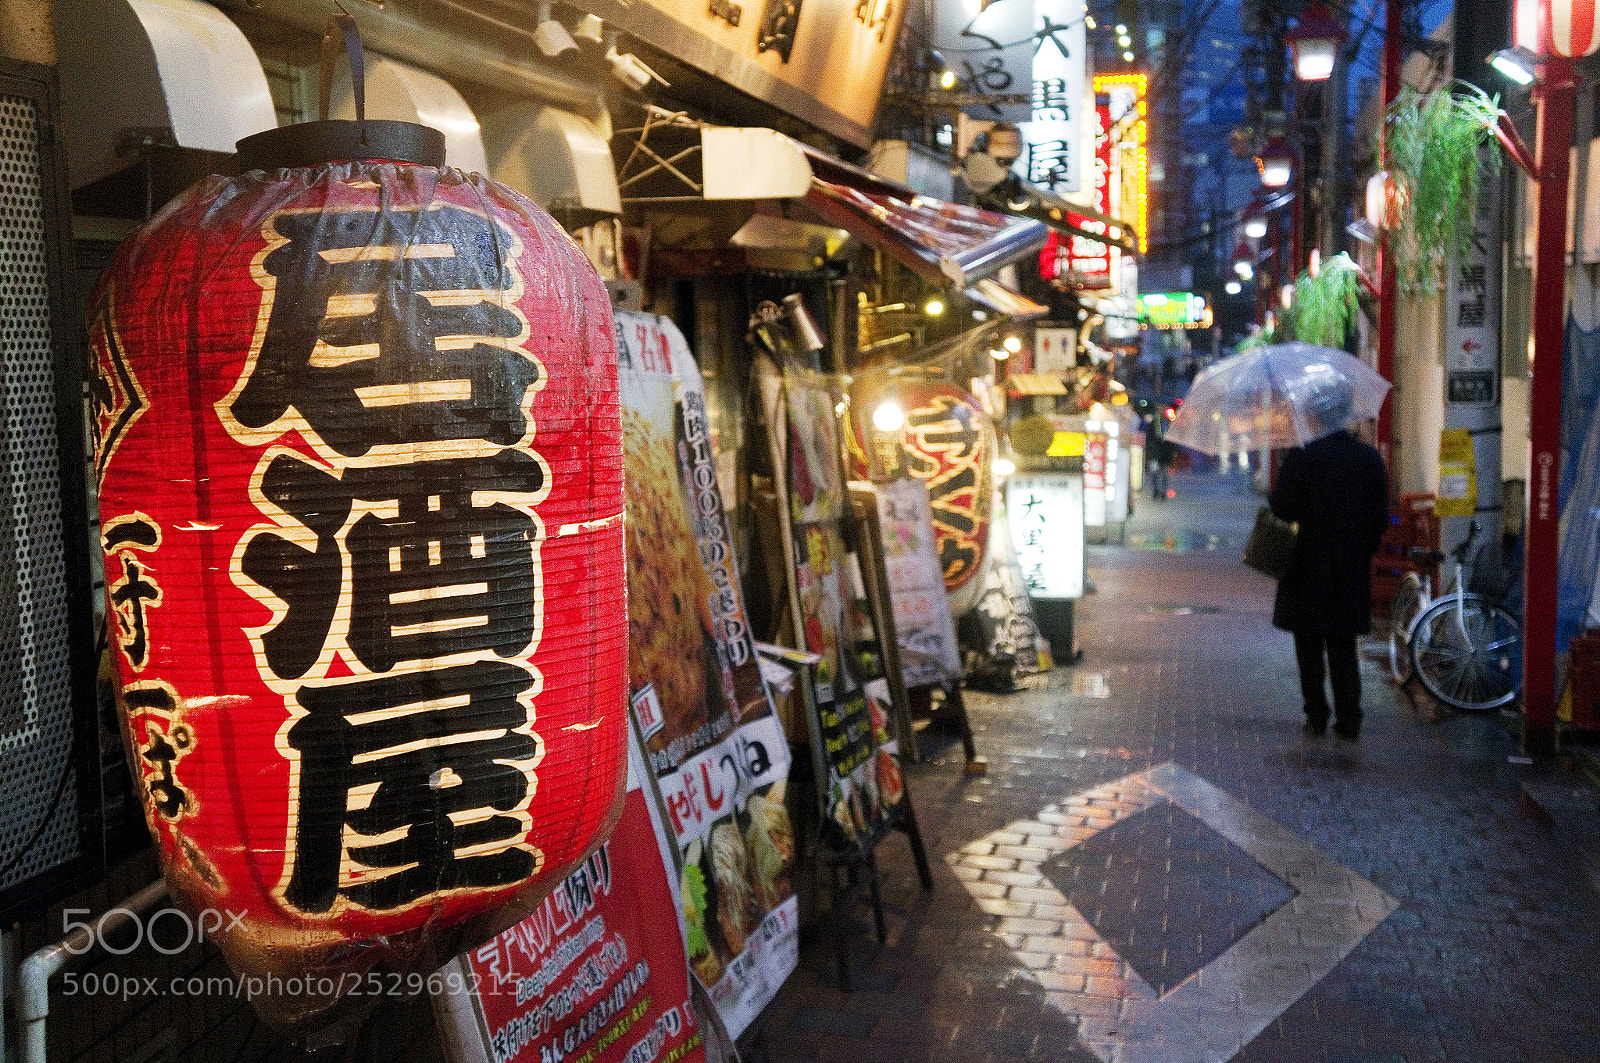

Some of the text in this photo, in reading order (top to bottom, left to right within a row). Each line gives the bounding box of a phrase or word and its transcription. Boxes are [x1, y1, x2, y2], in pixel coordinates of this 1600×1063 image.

[1027, 15, 1069, 190] 大黒屋
[214, 202, 553, 920] 居酒屋
